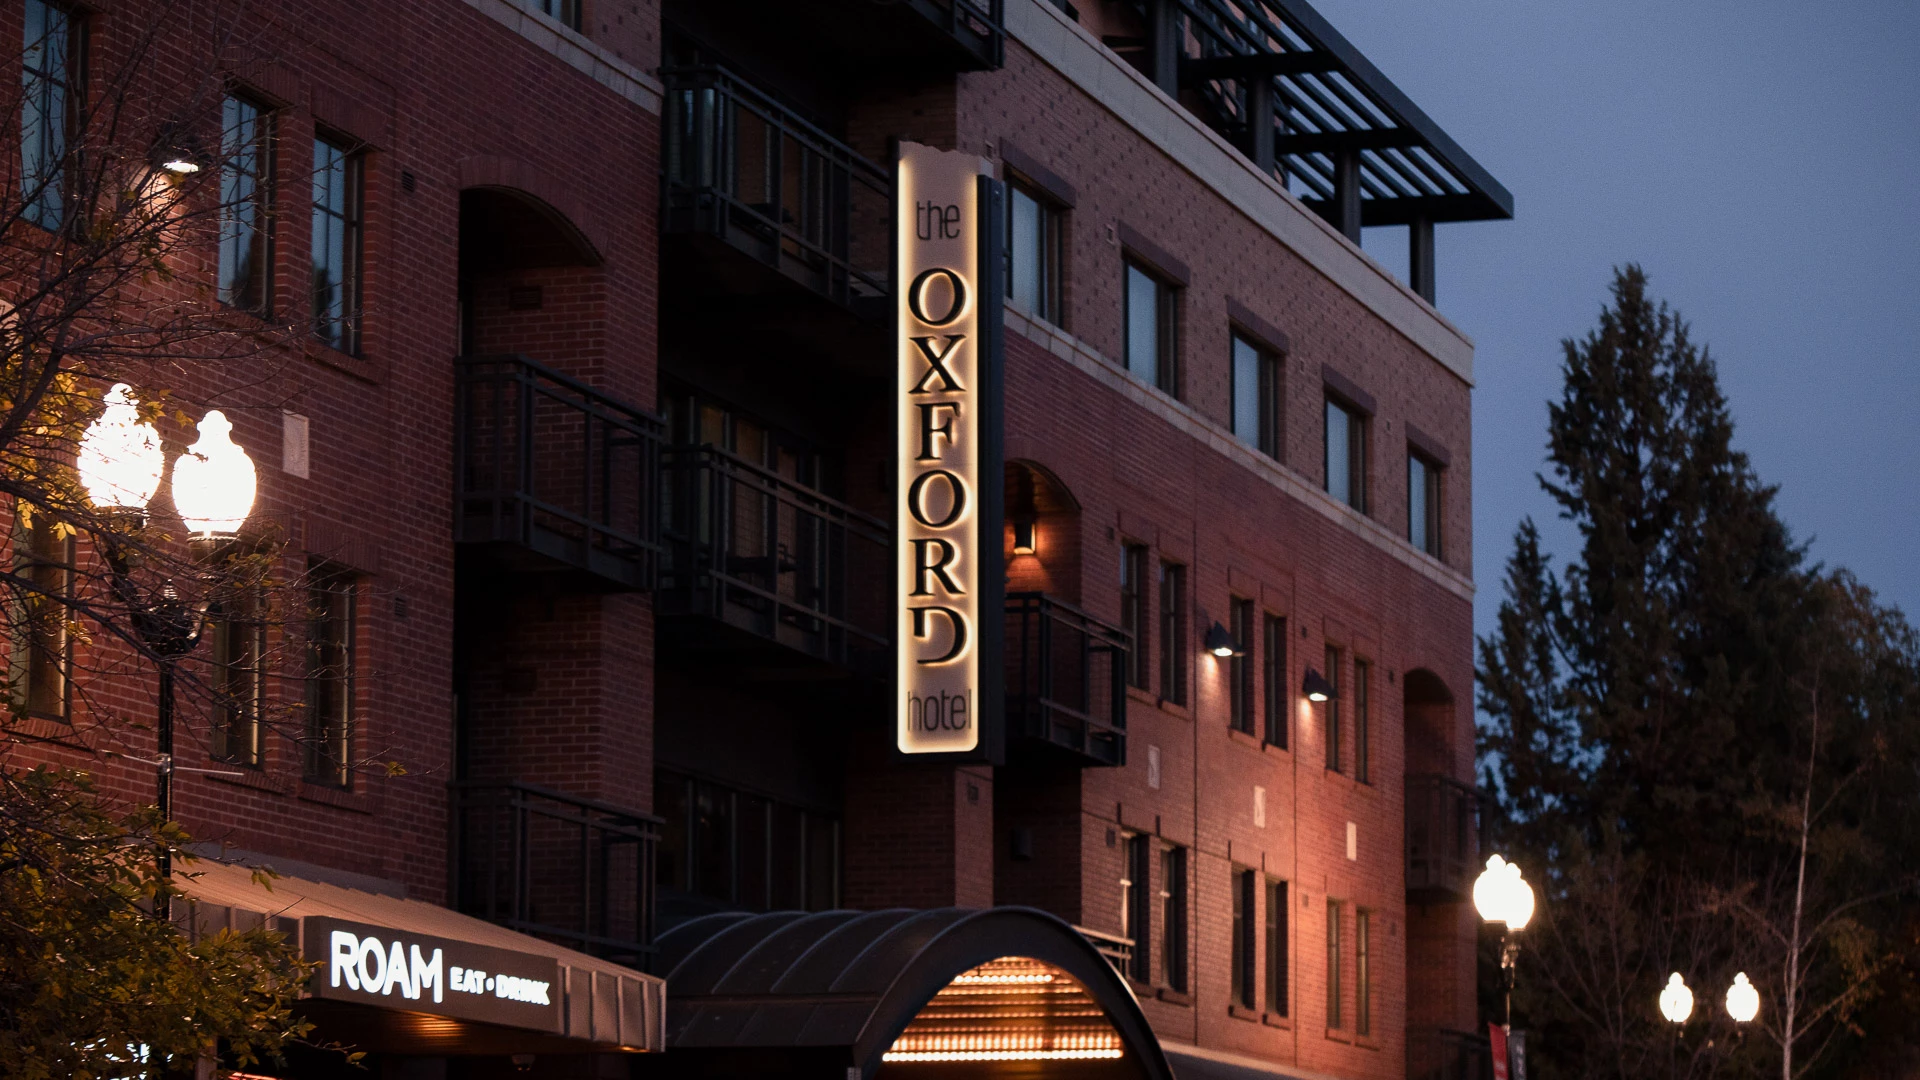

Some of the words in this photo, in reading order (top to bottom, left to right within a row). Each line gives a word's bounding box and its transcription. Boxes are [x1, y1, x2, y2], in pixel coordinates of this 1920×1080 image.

[916, 200, 961, 241] the
[907, 267, 969, 665] OXFORD
[907, 688, 972, 732] hotel
[331, 930, 443, 1004] ROAM
